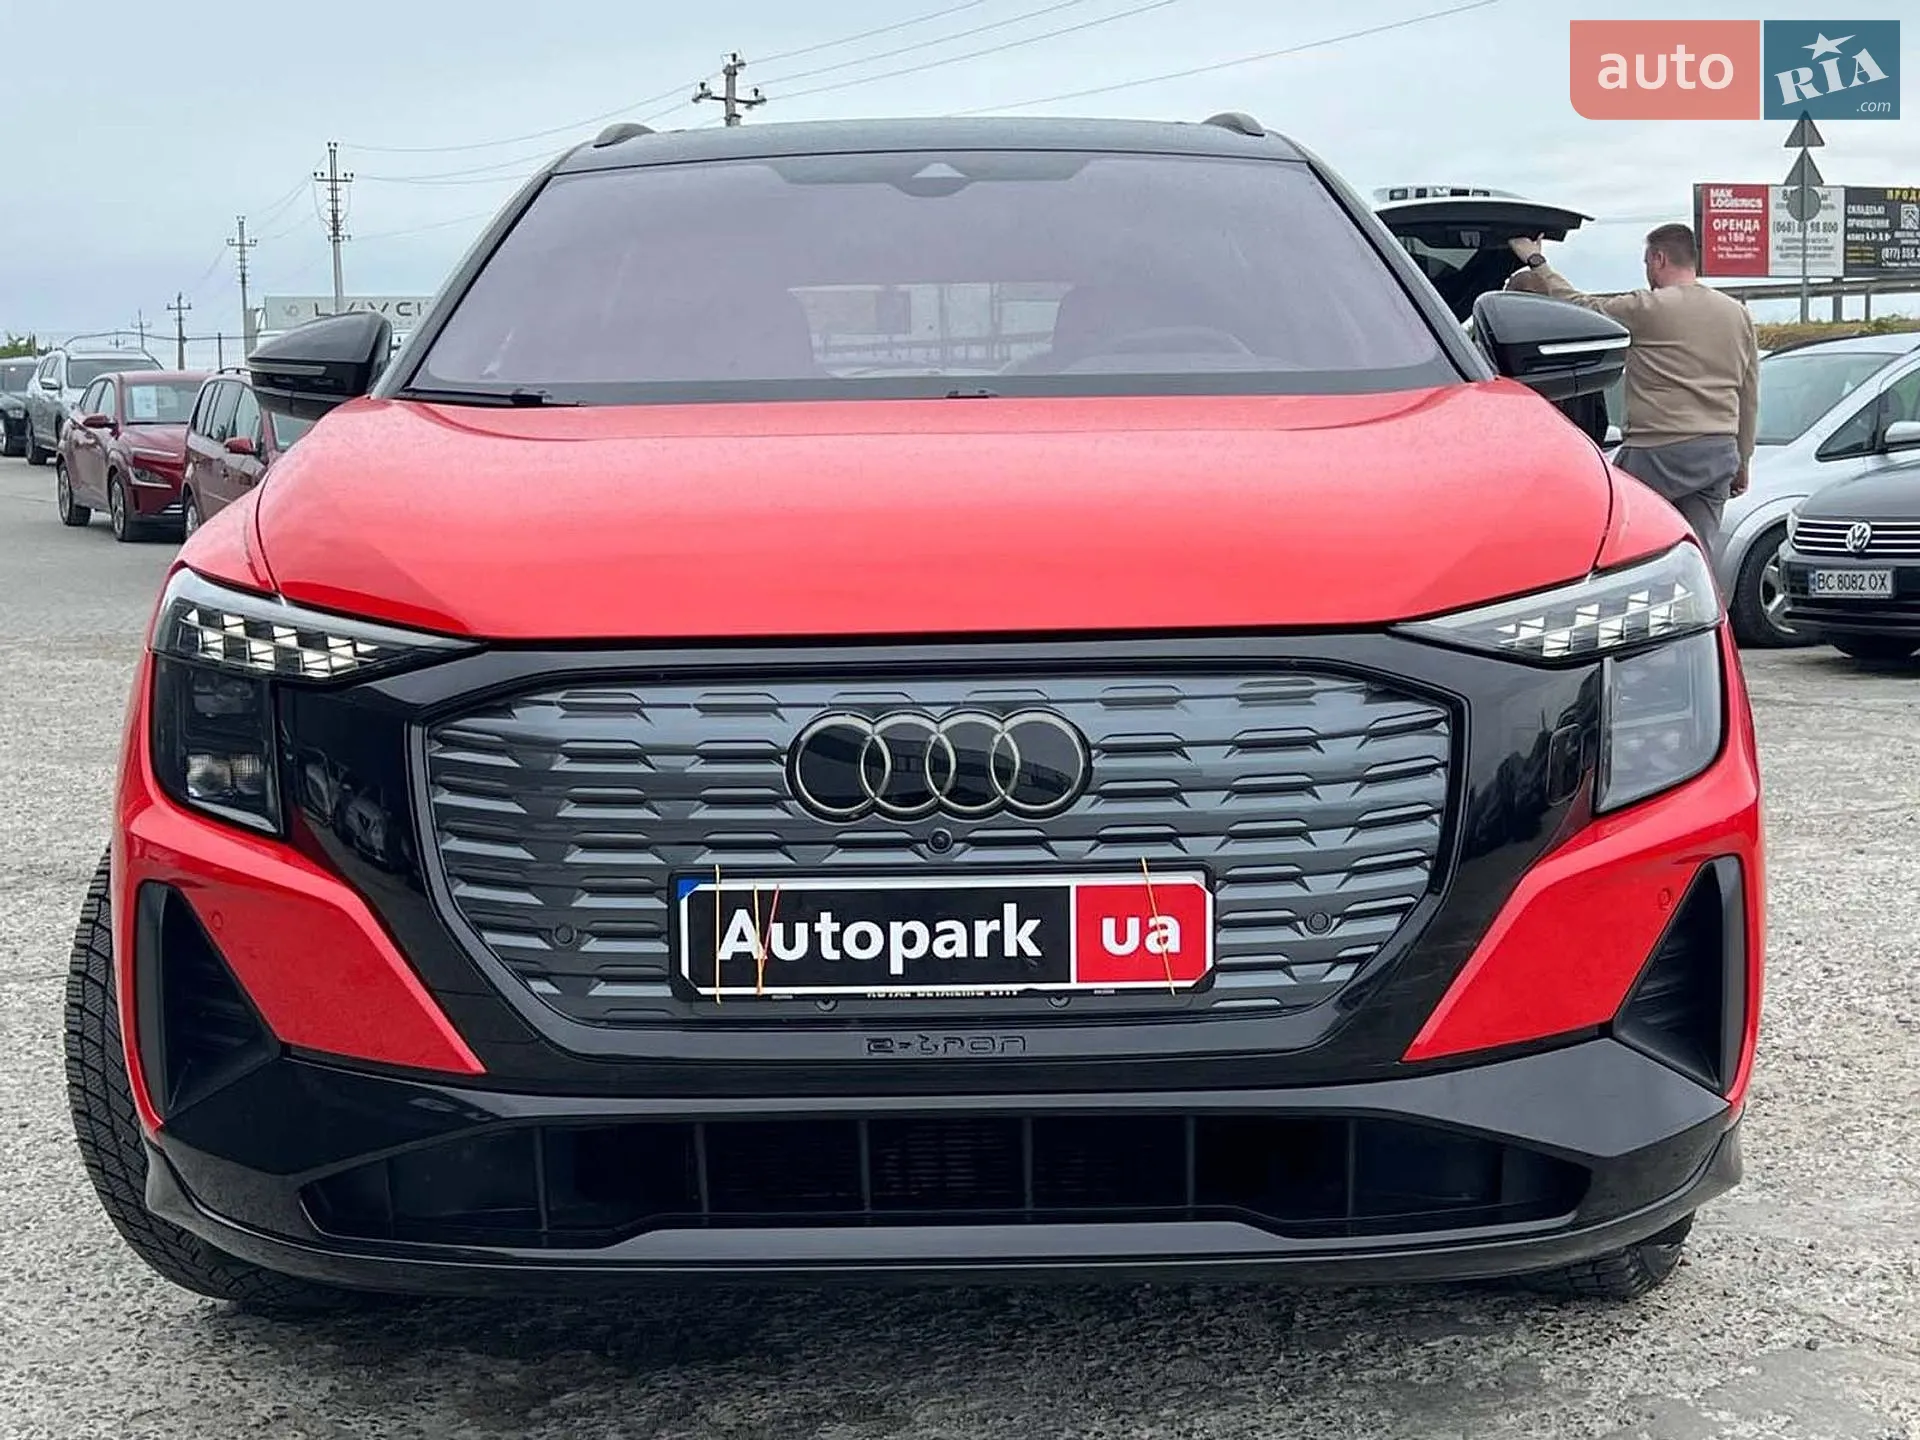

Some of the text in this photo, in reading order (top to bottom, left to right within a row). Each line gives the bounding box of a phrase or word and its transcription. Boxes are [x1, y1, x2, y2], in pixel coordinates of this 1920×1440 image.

[1709, 188, 1733, 198] MAX
[1712, 218, 1760, 234] ОРЕНДА
[1817, 573, 1887, 591] BC 8082 OX
[719, 902, 1181, 976] Autopark ua
[866, 1034, 1027, 1056] e-tron
